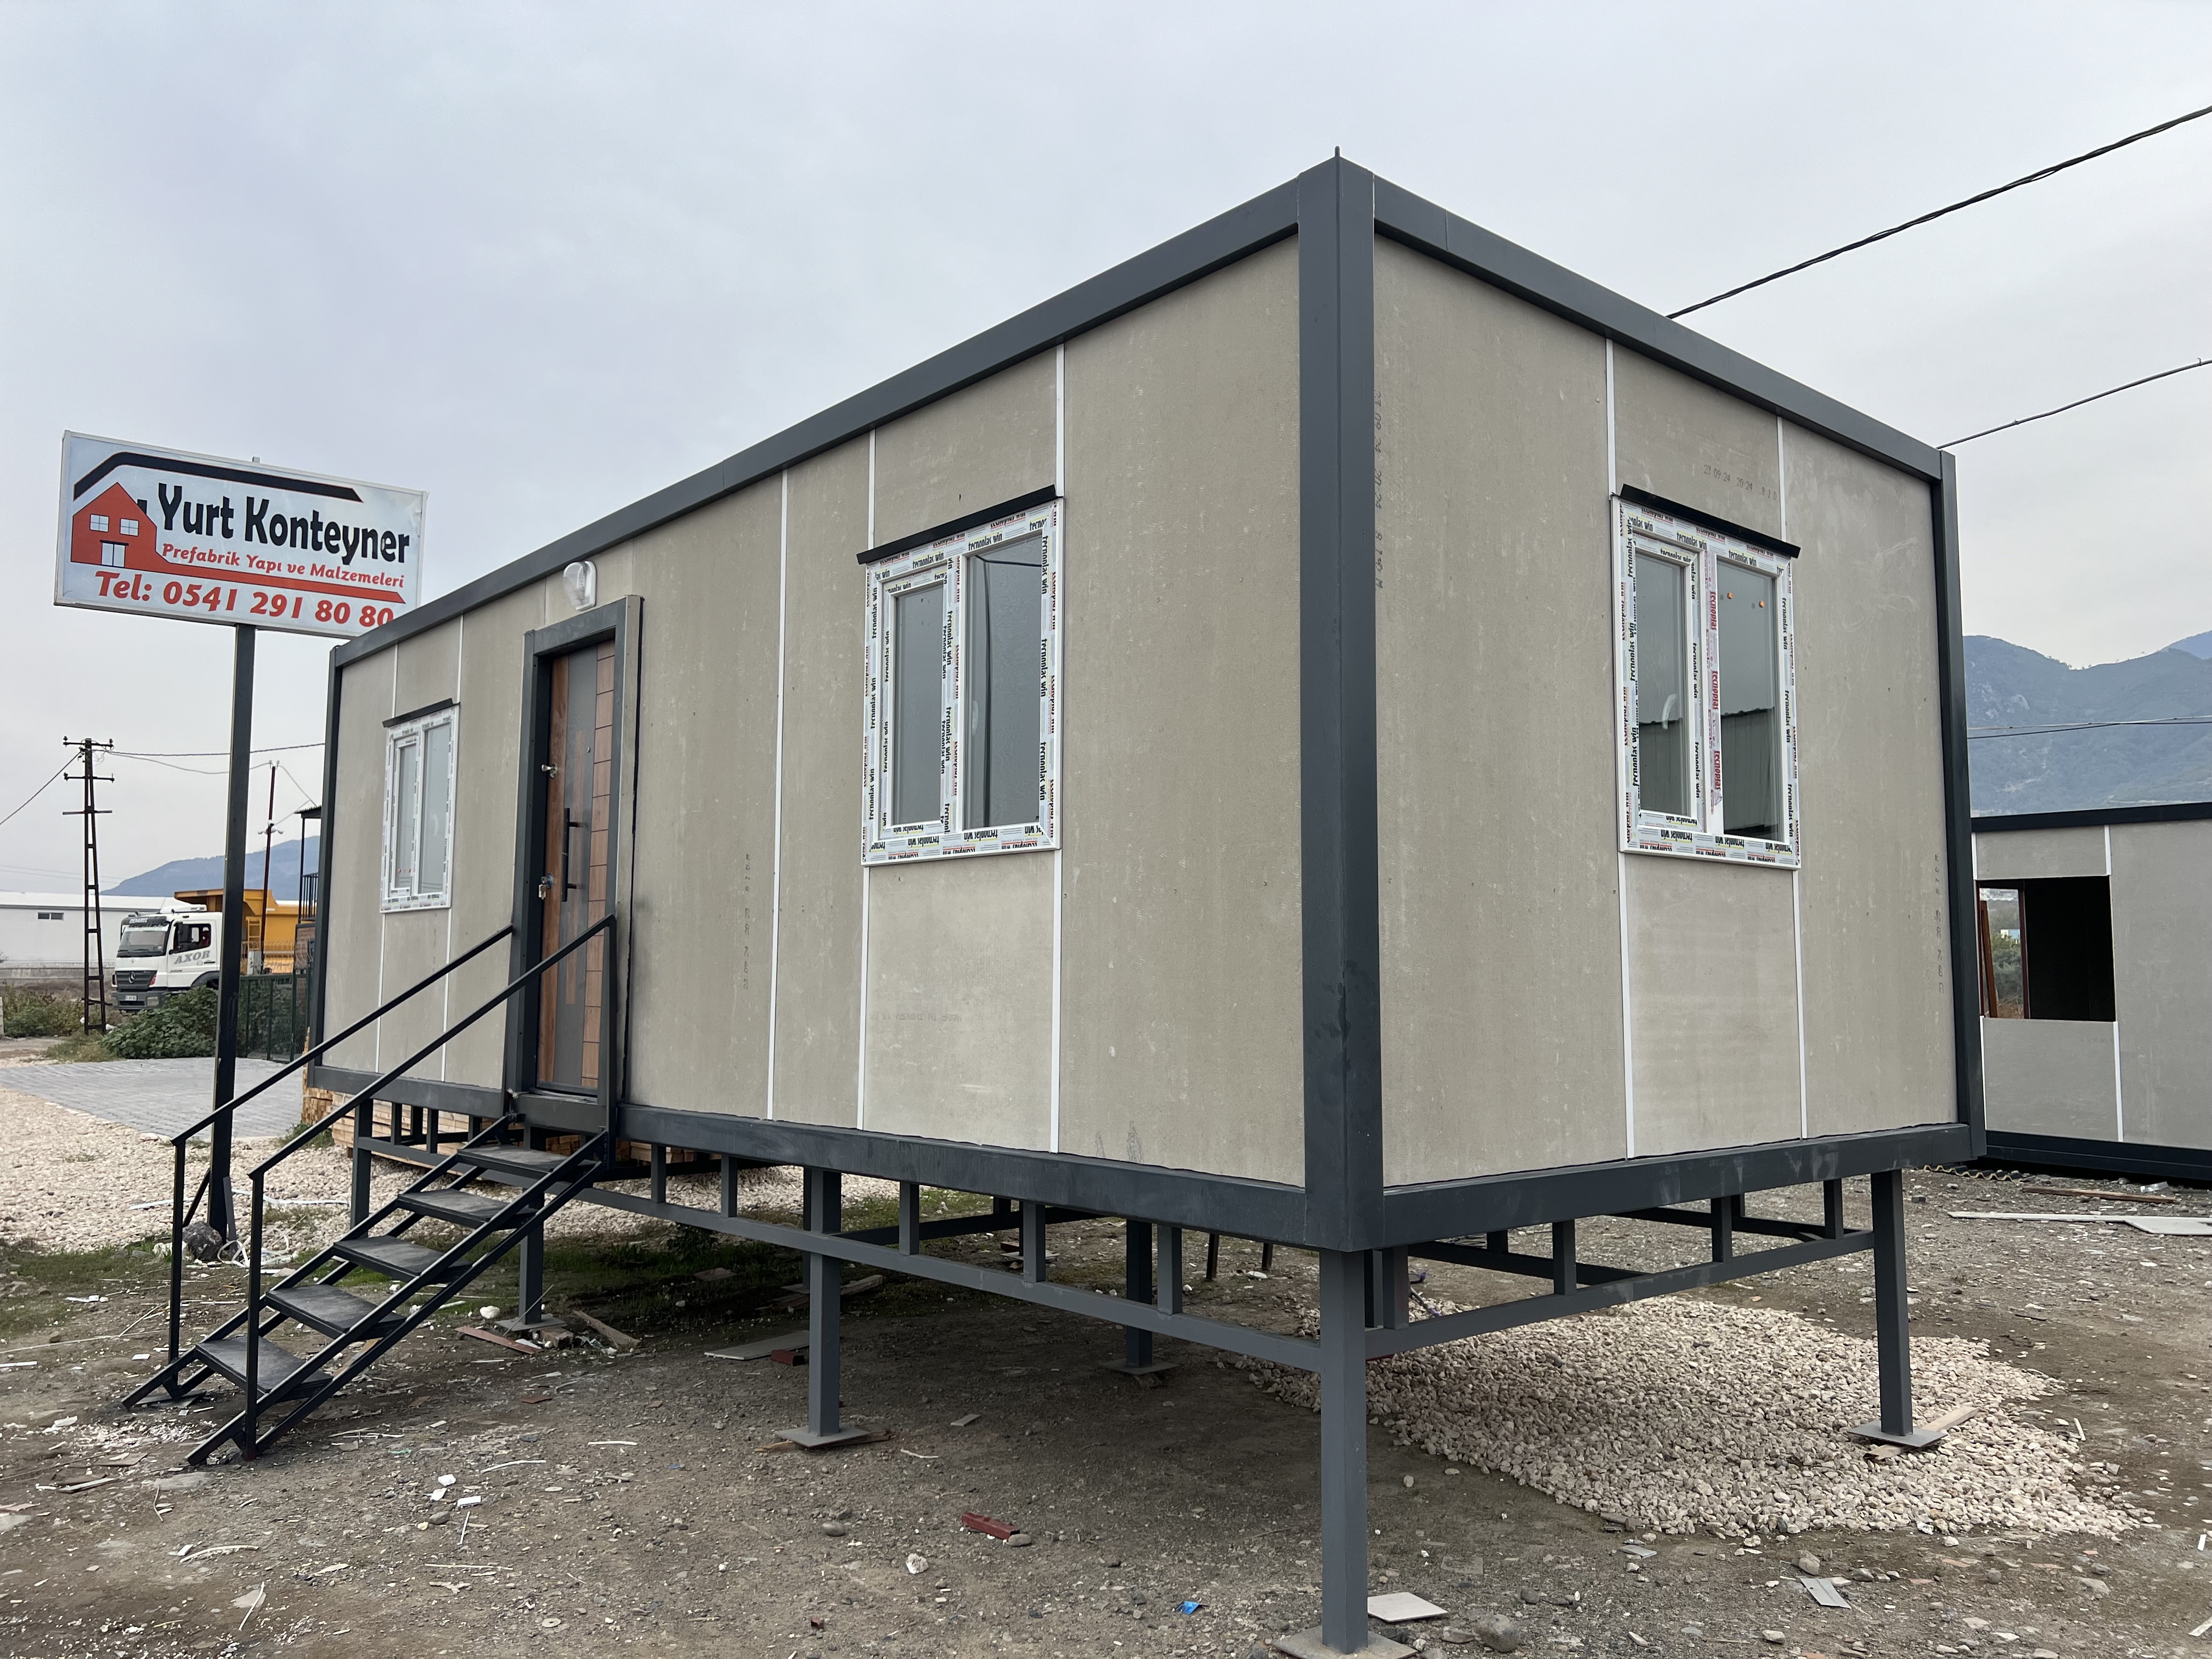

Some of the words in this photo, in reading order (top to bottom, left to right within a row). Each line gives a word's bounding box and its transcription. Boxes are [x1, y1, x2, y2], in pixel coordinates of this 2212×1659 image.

[158, 482, 234, 539] Yurt
[245, 496, 410, 566] Konteyner
[162, 543, 240, 567] Prefabrik
[246, 555, 282, 574] Yapı
[287, 562, 305, 574] ve
[310, 563, 405, 588] Malzemeleri
[95, 571, 153, 601] Tel:
[163, 580, 238, 612] 0541
[250, 591, 303, 619] 291
[315, 600, 351, 624] 80
[359, 605, 394, 627] 80
[174, 950, 211, 964] AXOR
